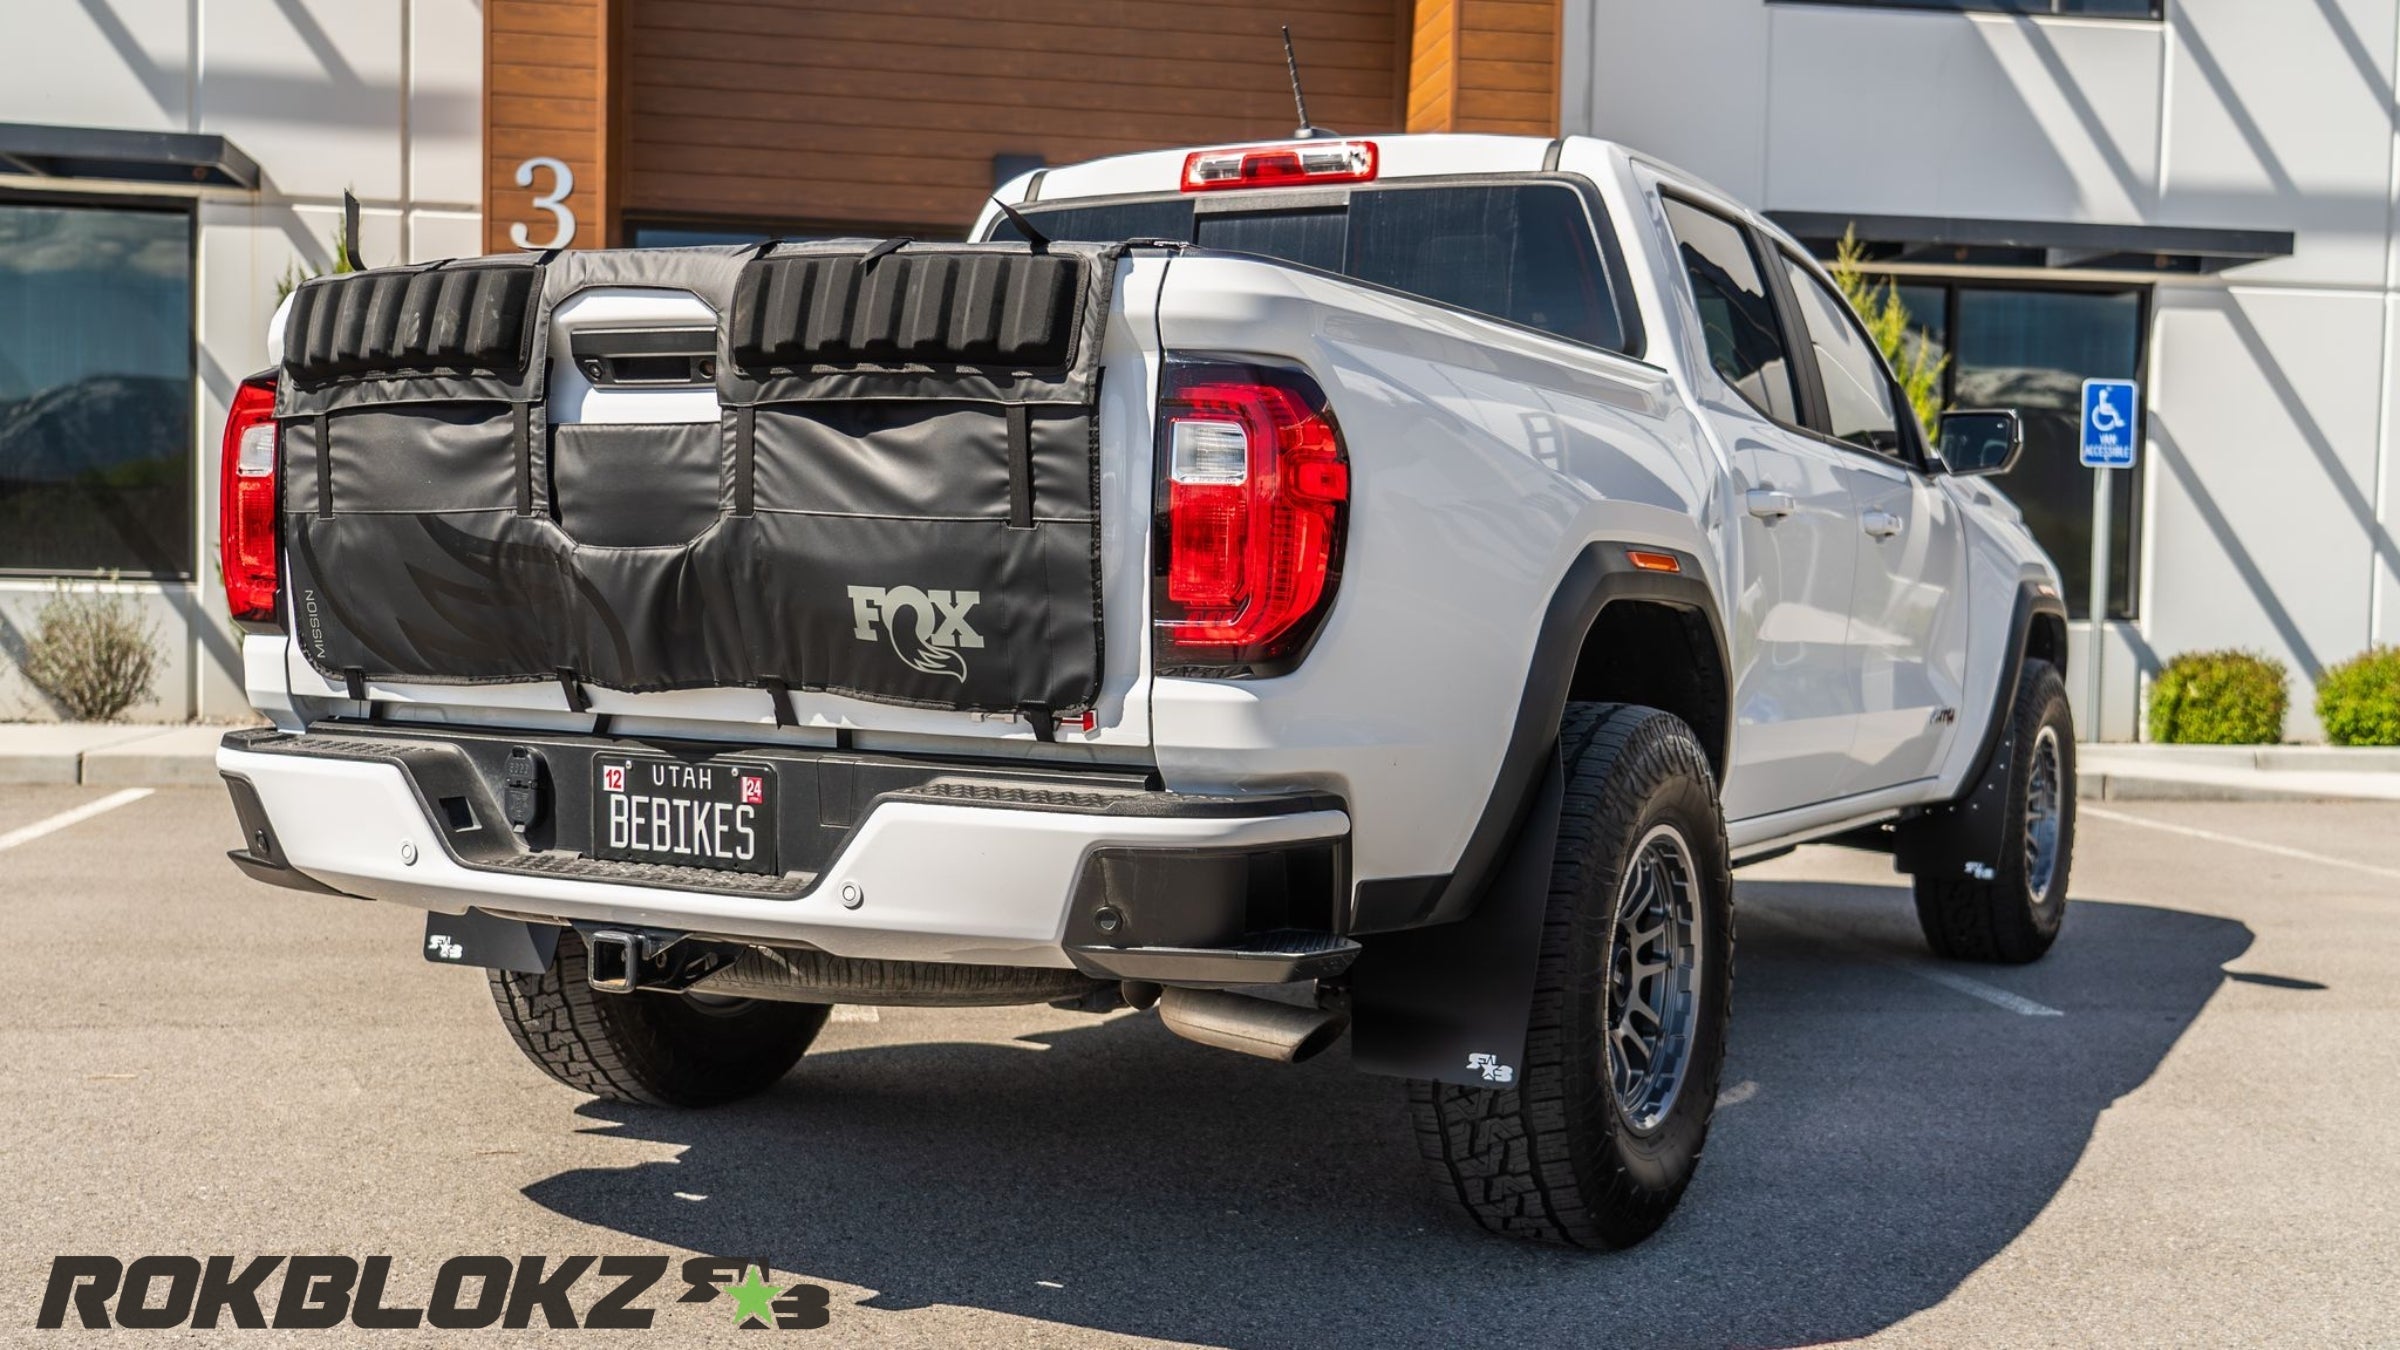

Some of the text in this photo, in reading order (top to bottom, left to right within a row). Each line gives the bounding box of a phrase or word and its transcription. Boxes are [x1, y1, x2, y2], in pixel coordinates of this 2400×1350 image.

[510, 157, 576, 250] 3
[2099, 433, 2117, 445] VAN
[2085, 445, 2130, 459] ACCESSIBLE
[305, 590, 326, 658] MISSION
[847, 585, 985, 683] FOX
[606, 769, 622, 789] 12
[653, 765, 712, 790] UTAH
[747, 779, 762, 797] 24
[610, 794, 755, 860] BEBIKES
